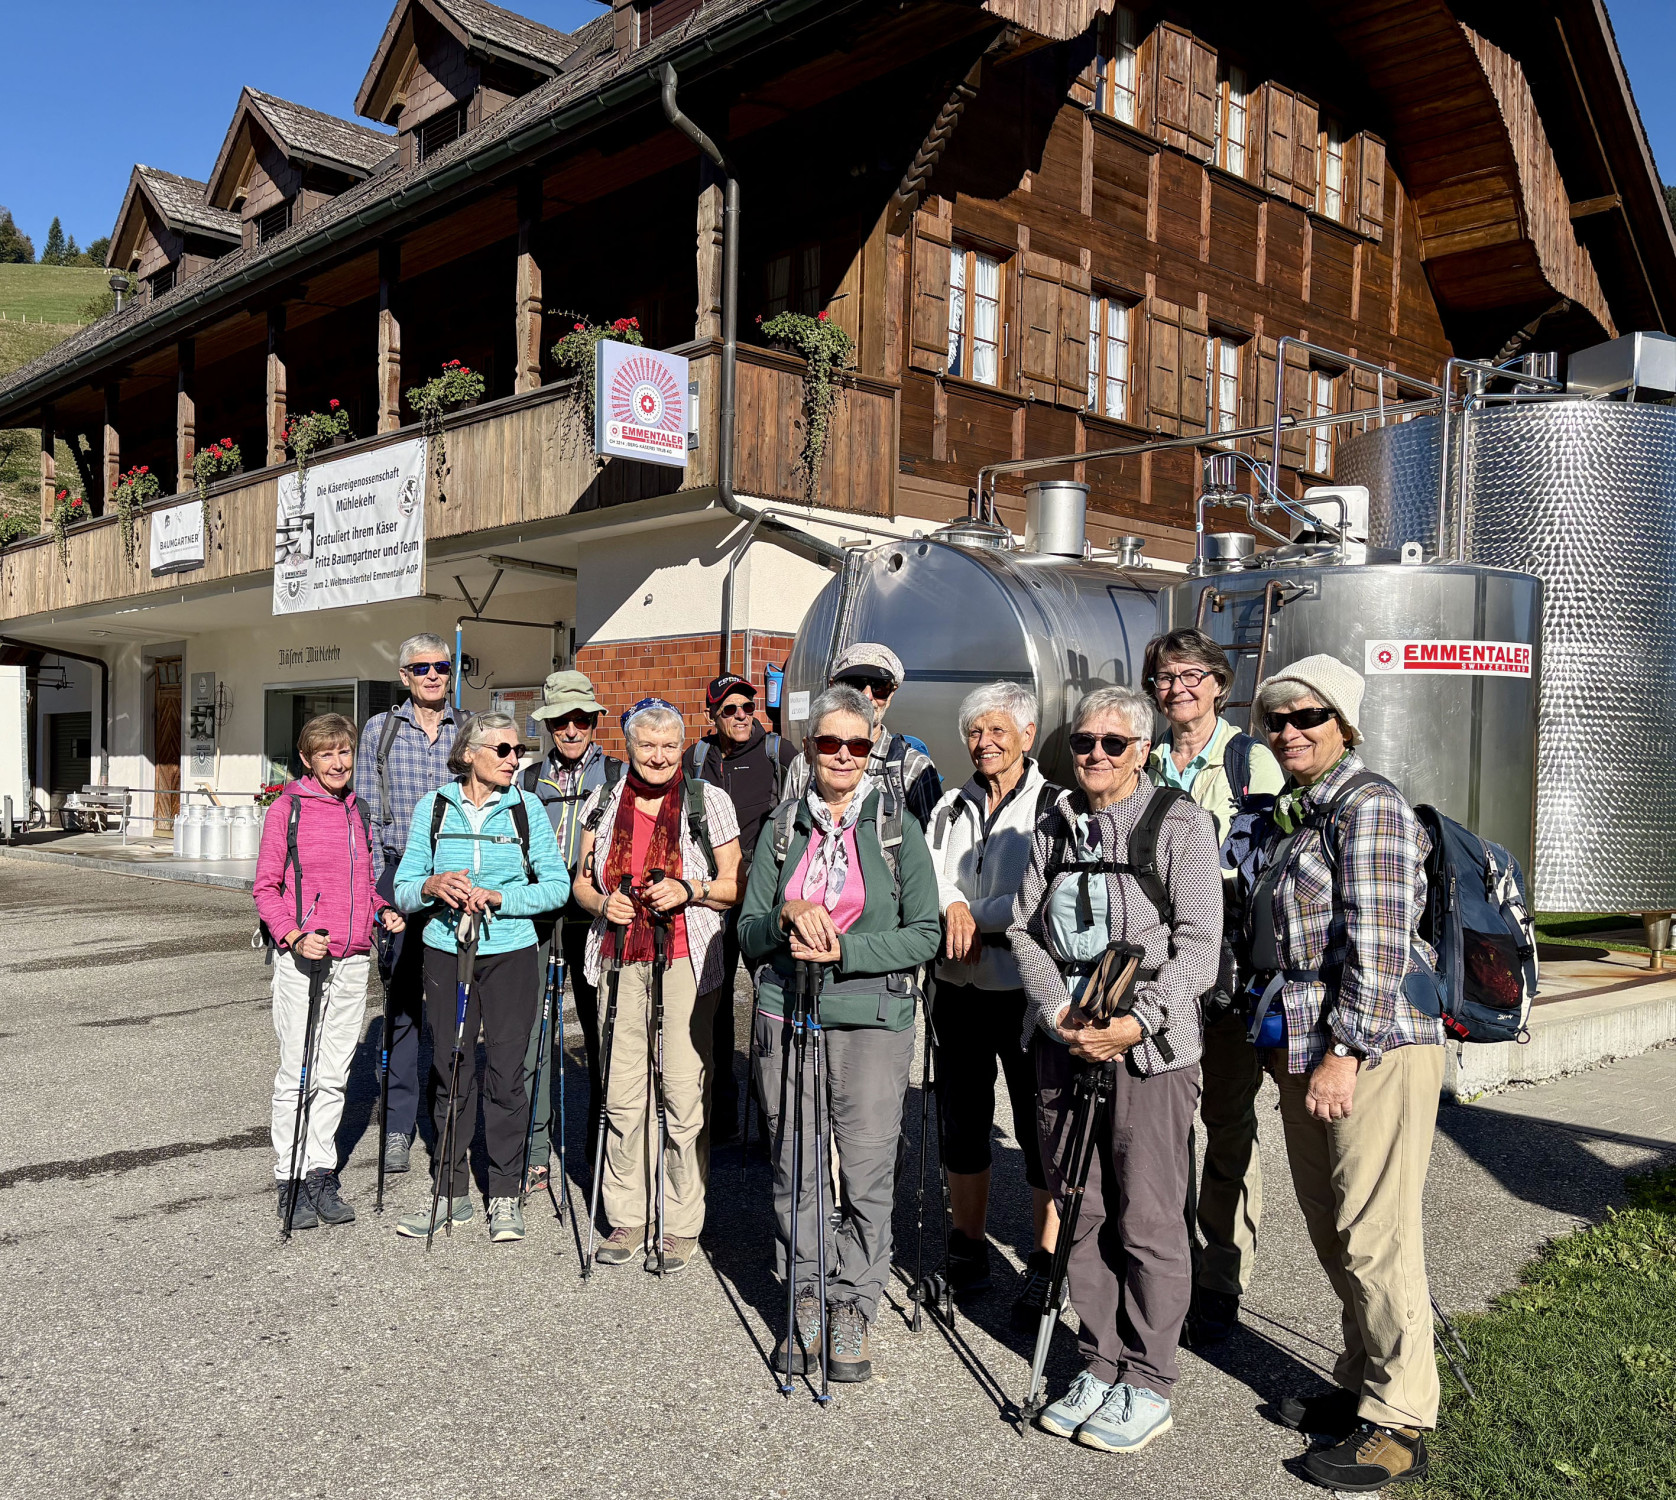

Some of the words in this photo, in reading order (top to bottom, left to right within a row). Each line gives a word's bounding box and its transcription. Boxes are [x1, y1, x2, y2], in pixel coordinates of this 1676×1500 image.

[622, 426, 683, 445] EMMENTALER
[317, 483, 326, 497] Die
[327, 467, 399, 494] Käsereigenossenschaft
[336, 493, 376, 513] Mühlekehr
[160, 534, 198, 550] BAUMGARTNER
[316, 529, 350, 547] Gratuliert
[352, 526, 374, 540] ihrem
[376, 521, 398, 537] Käser
[315, 555, 331, 569] Fritz
[331, 548, 381, 566] Baumgartner
[383, 543, 399, 557] und
[400, 540, 419, 554] Team
[313, 581, 324, 590] zum
[324, 579, 330, 589] 2.
[330, 571, 372, 587] Weltmeistertitel
[373, 567, 405, 581] Emmentaler
[405, 564, 419, 575] AOP
[1404, 644, 1530, 665] EMMENTALER
[1461, 663, 1526, 673] SWITZERLAND
